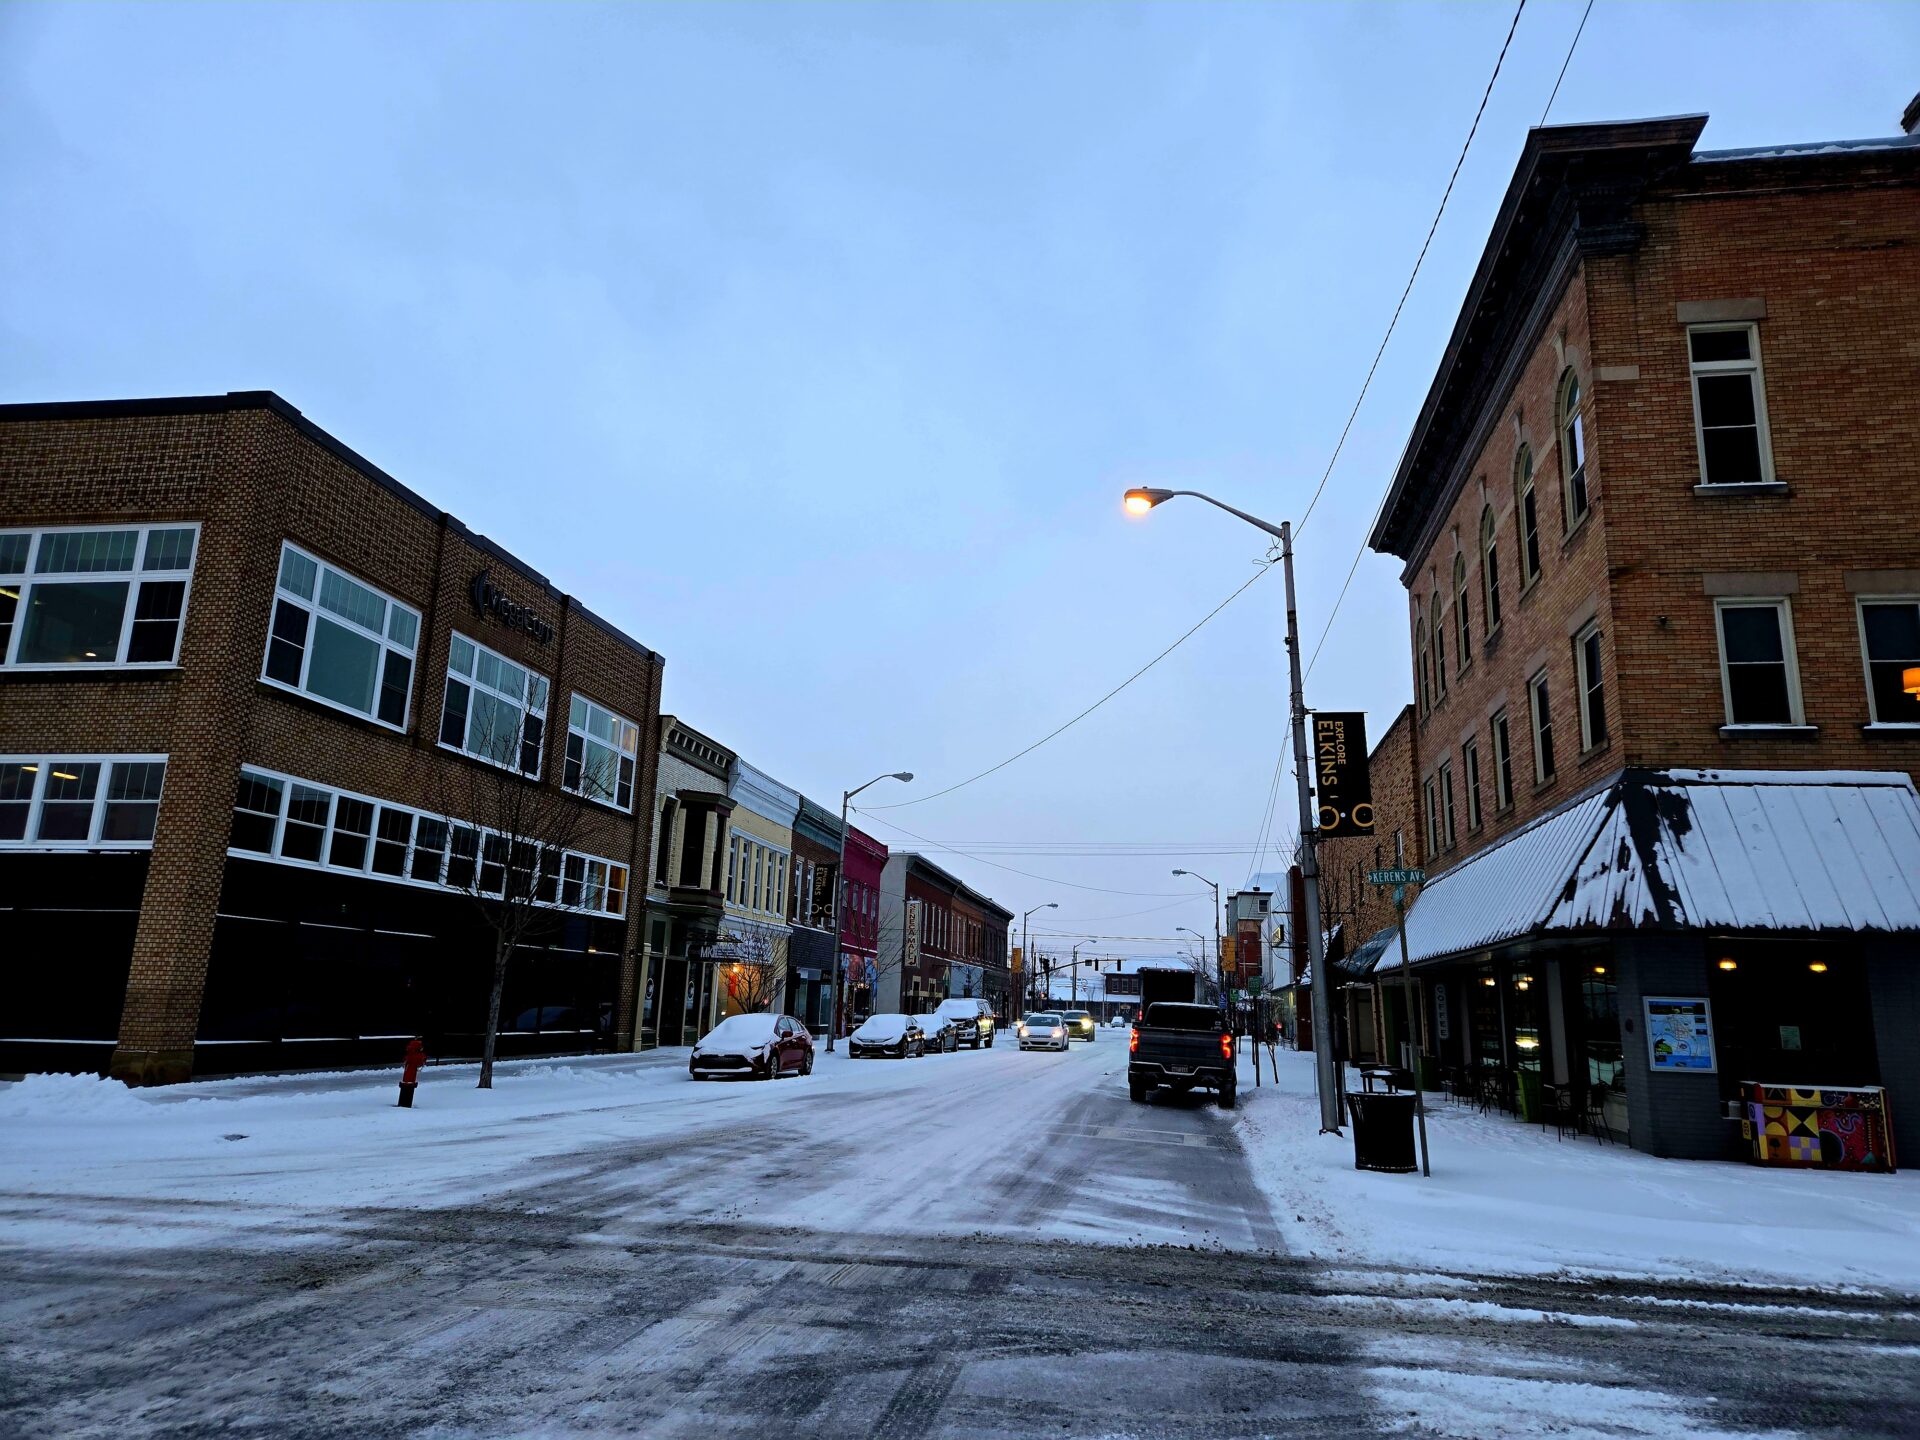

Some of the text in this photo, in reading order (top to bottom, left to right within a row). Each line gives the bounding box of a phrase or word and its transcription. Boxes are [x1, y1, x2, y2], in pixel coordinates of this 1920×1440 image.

[1317, 720, 1338, 786] ELKINS
[1334, 721, 1347, 765] EXPLORE
[814, 867, 824, 896] ELKINS
[1372, 871, 1420, 883] KERENS AV
[907, 903, 916, 960] SENECA MALL
[1437, 986, 1447, 1036] COFFEE
